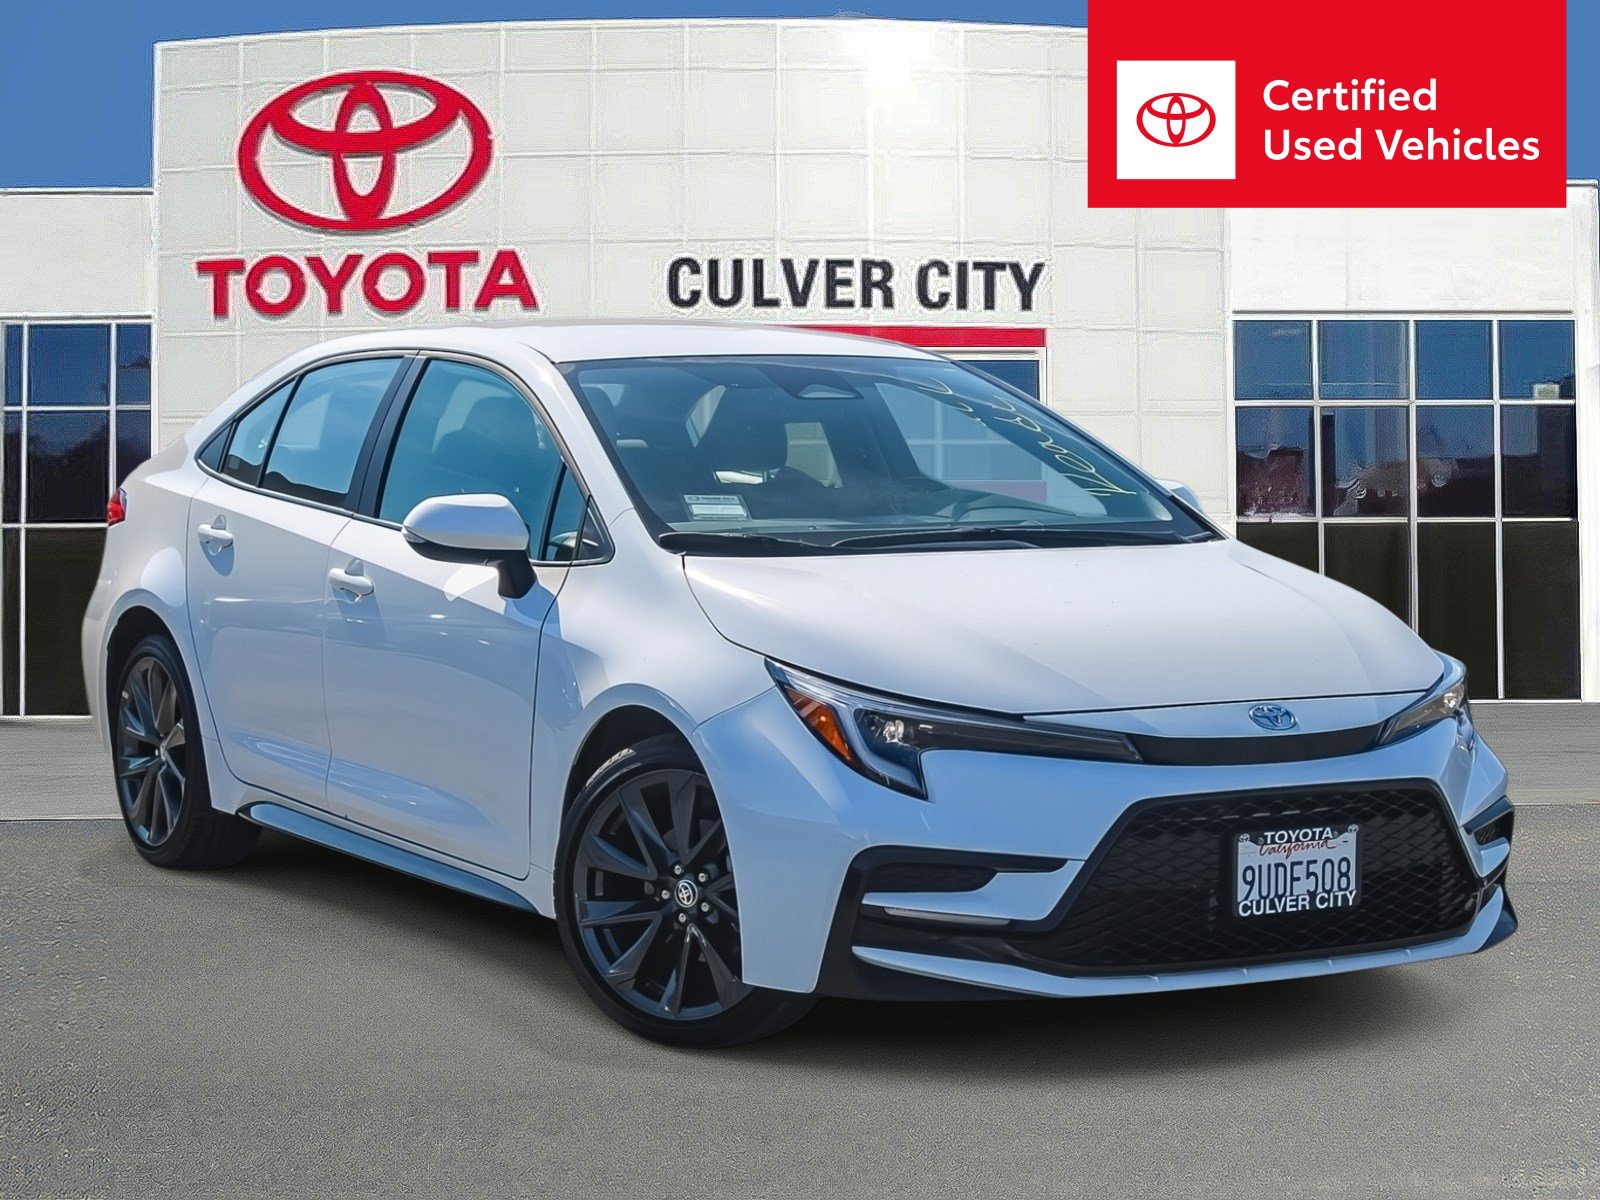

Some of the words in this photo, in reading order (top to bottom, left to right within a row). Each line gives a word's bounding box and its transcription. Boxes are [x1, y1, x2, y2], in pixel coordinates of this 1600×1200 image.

[196, 249, 539, 319] TOYOTA
[667, 257, 895, 309] CULVER
[916, 259, 1045, 311] CITY
[1260, 840, 1336, 859] California
[1264, 827, 1333, 844] TOYOTA
[1242, 857, 1351, 900] 9UDF508
[1239, 894, 1310, 917] CULVER
[1316, 889, 1357, 909] CITY
